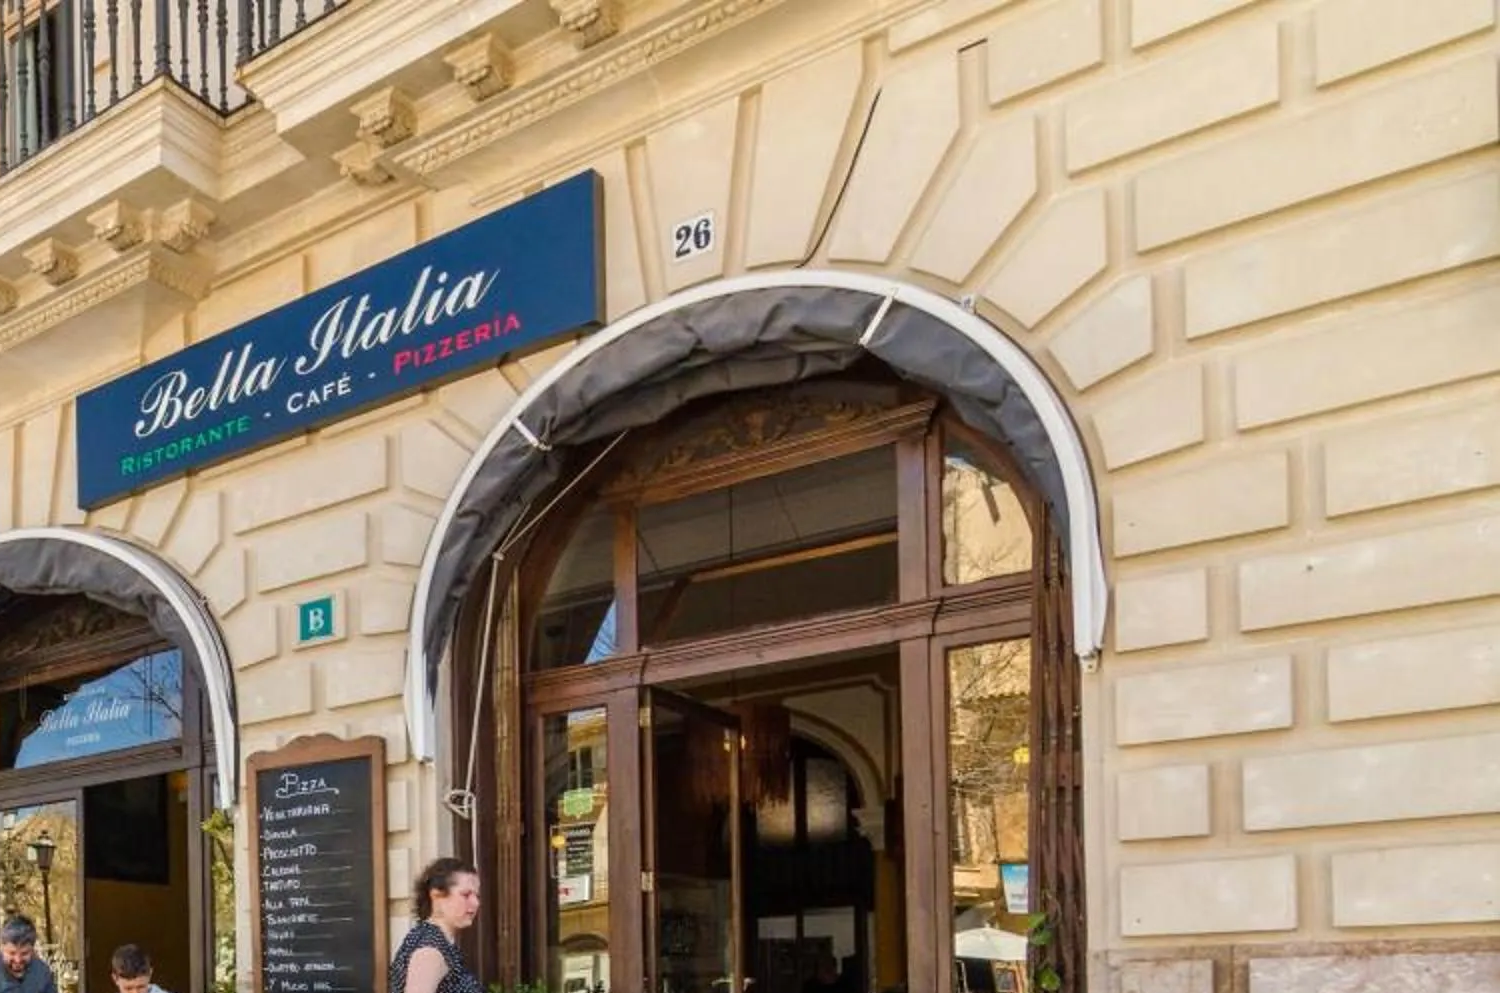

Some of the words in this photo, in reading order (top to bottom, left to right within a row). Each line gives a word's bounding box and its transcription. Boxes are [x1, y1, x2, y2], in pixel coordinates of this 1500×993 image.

[675, 218, 711, 258] 26
[120, 415, 250, 476] RISTORANTE
[286, 371, 351, 414] CAFÉ
[392, 311, 522, 376] PIZZERIA
[135, 342, 288, 438] Bella
[294, 265, 500, 376] Italia
[277, 773, 328, 796] PIZZA
